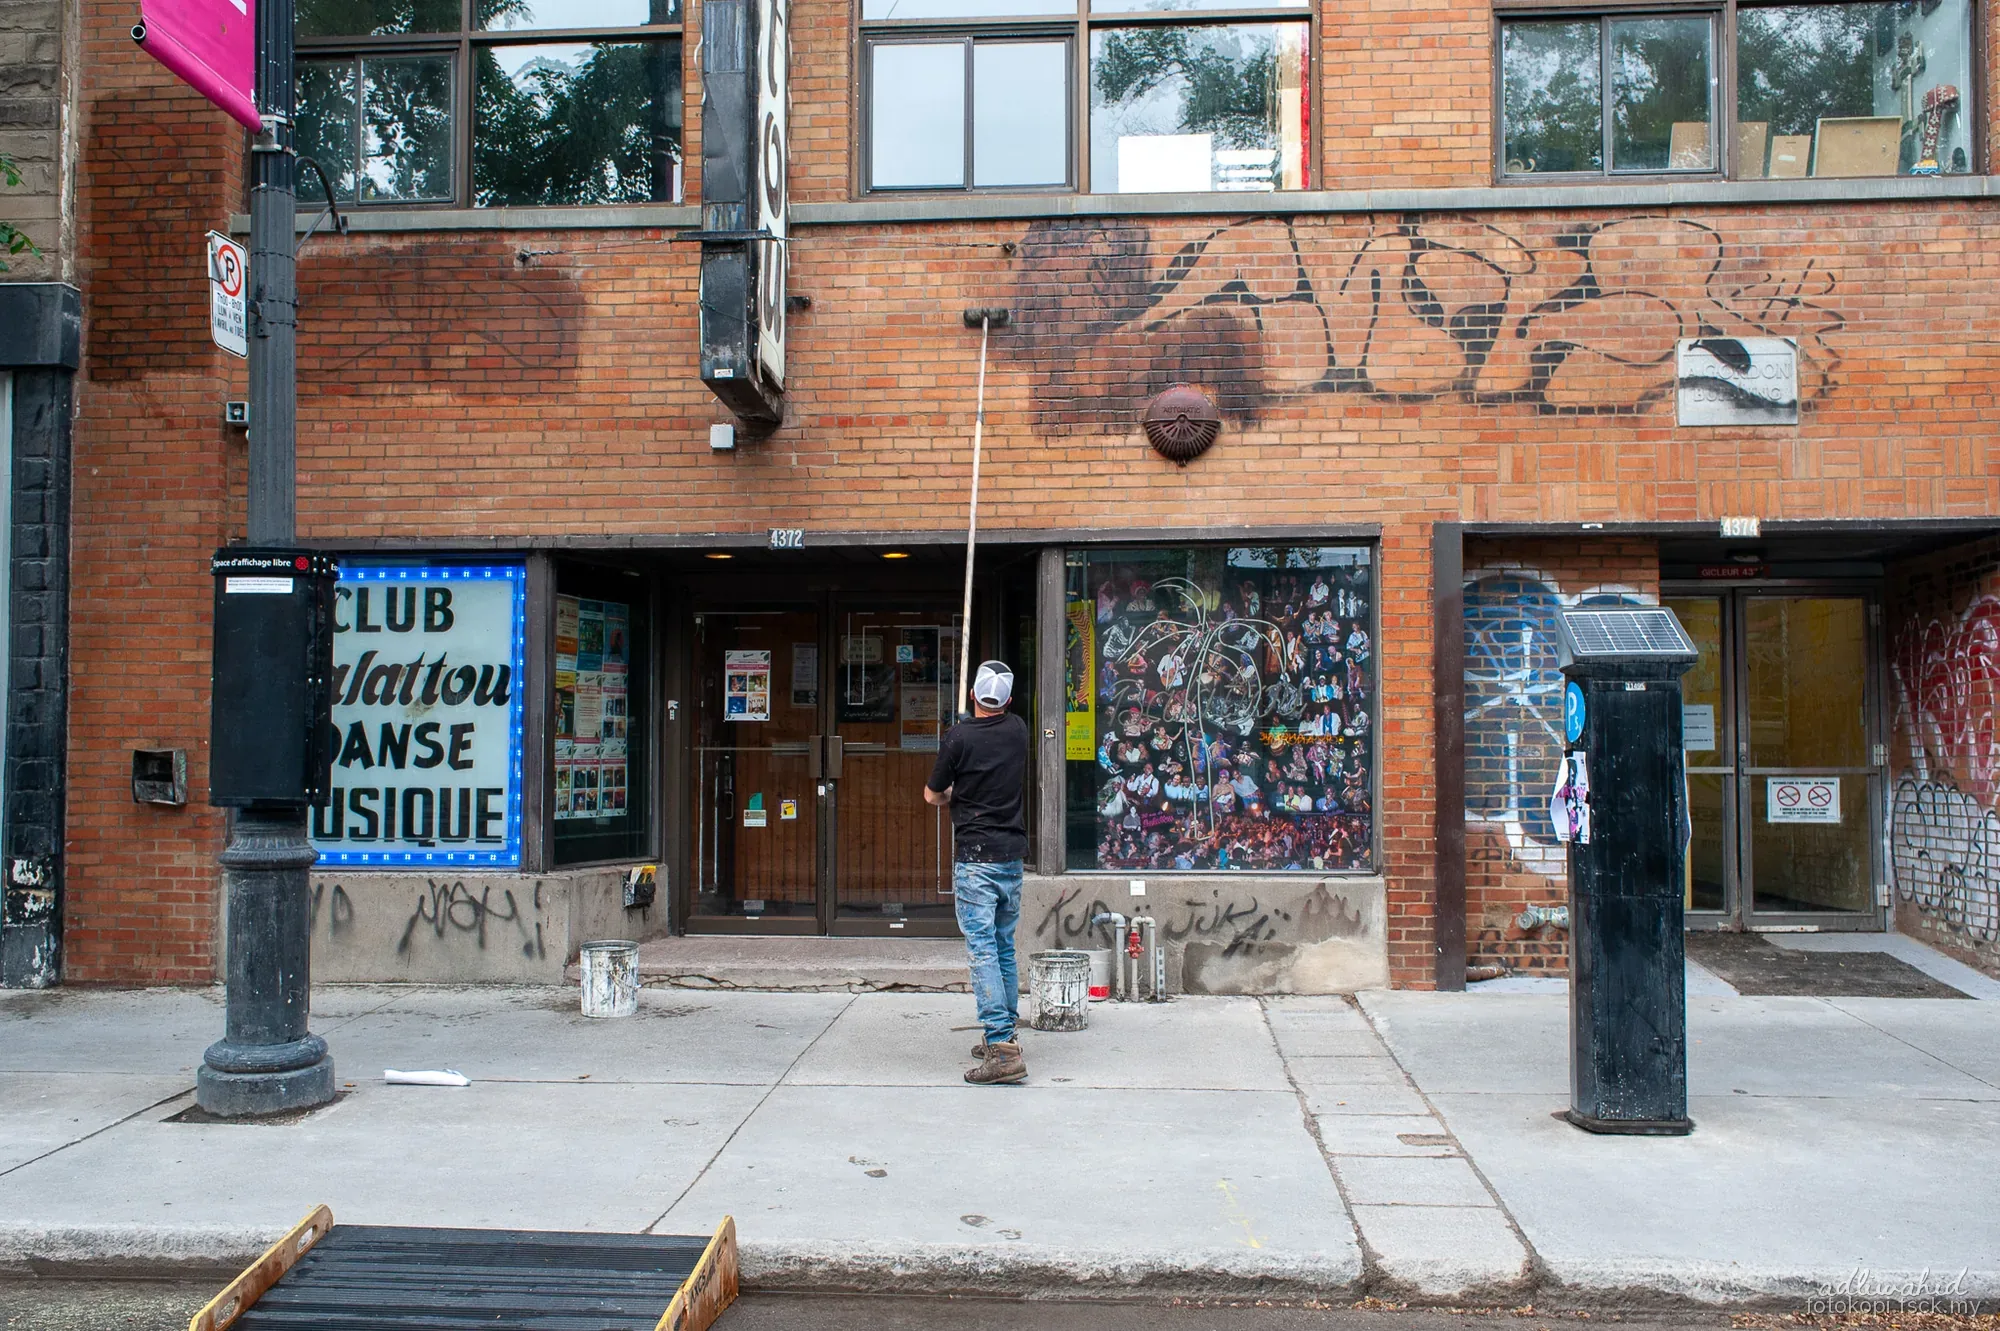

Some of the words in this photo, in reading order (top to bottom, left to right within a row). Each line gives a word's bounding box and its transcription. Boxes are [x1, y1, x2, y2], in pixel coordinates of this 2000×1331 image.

[1723, 518, 1758, 536] 4374
[771, 529, 802, 547] 4372
[231, 558, 272, 568] d'affichage
[272, 558, 291, 567] libre
[1701, 567, 1740, 577] GICLEUR
[333, 586, 455, 633] CLUB
[332, 650, 512, 706] alattou
[312, 787, 504, 848] USIQUE
